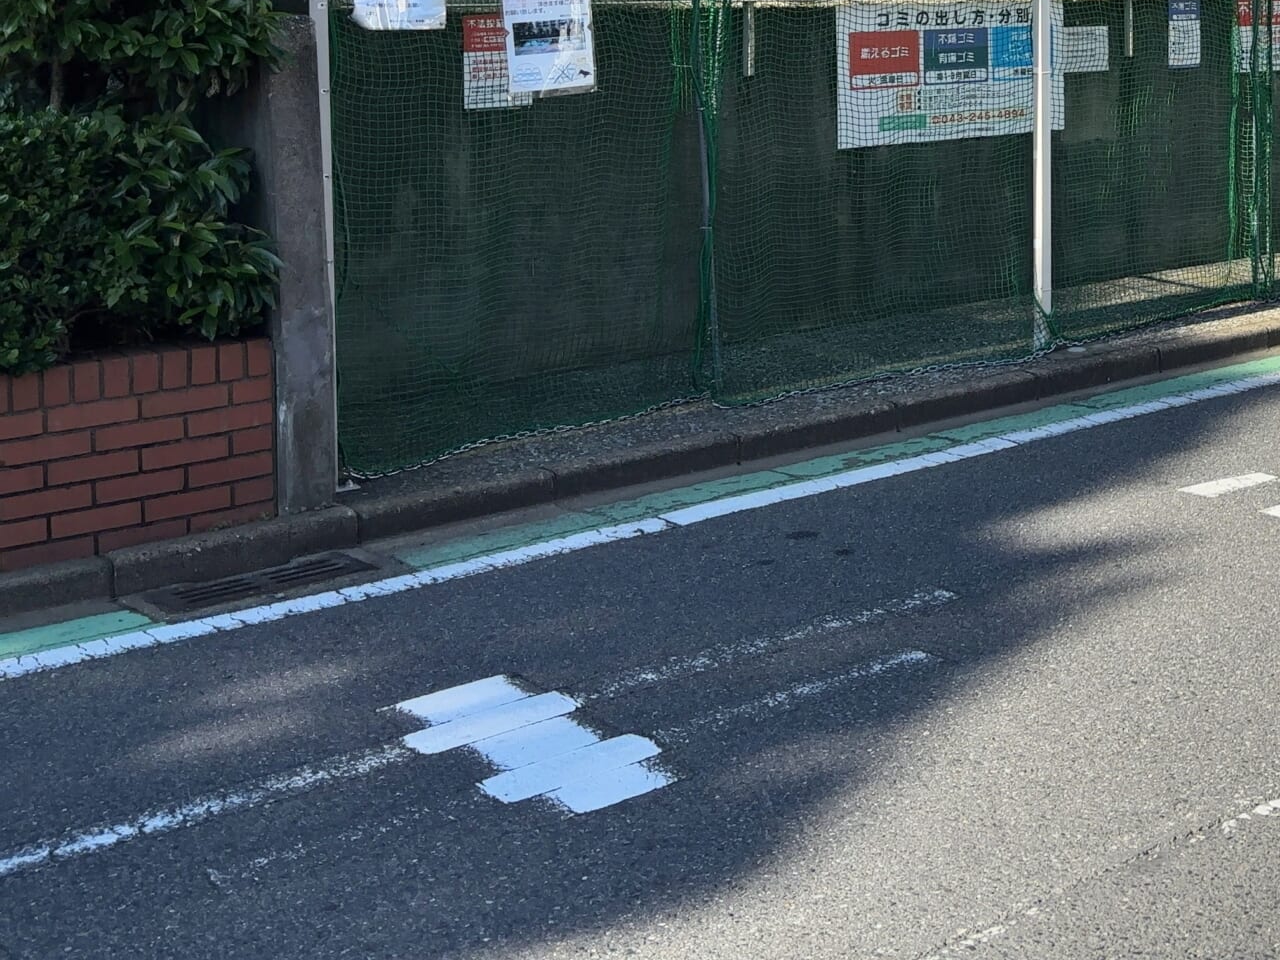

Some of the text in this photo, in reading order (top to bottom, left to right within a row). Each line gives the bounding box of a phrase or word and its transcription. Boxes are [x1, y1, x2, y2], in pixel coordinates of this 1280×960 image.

[877, 8, 1029, 27] ゴミの出し方・分別
[938, 32, 975, 45] 不燃ゴミ
[861, 45, 910, 60] 燃えるゴミ
